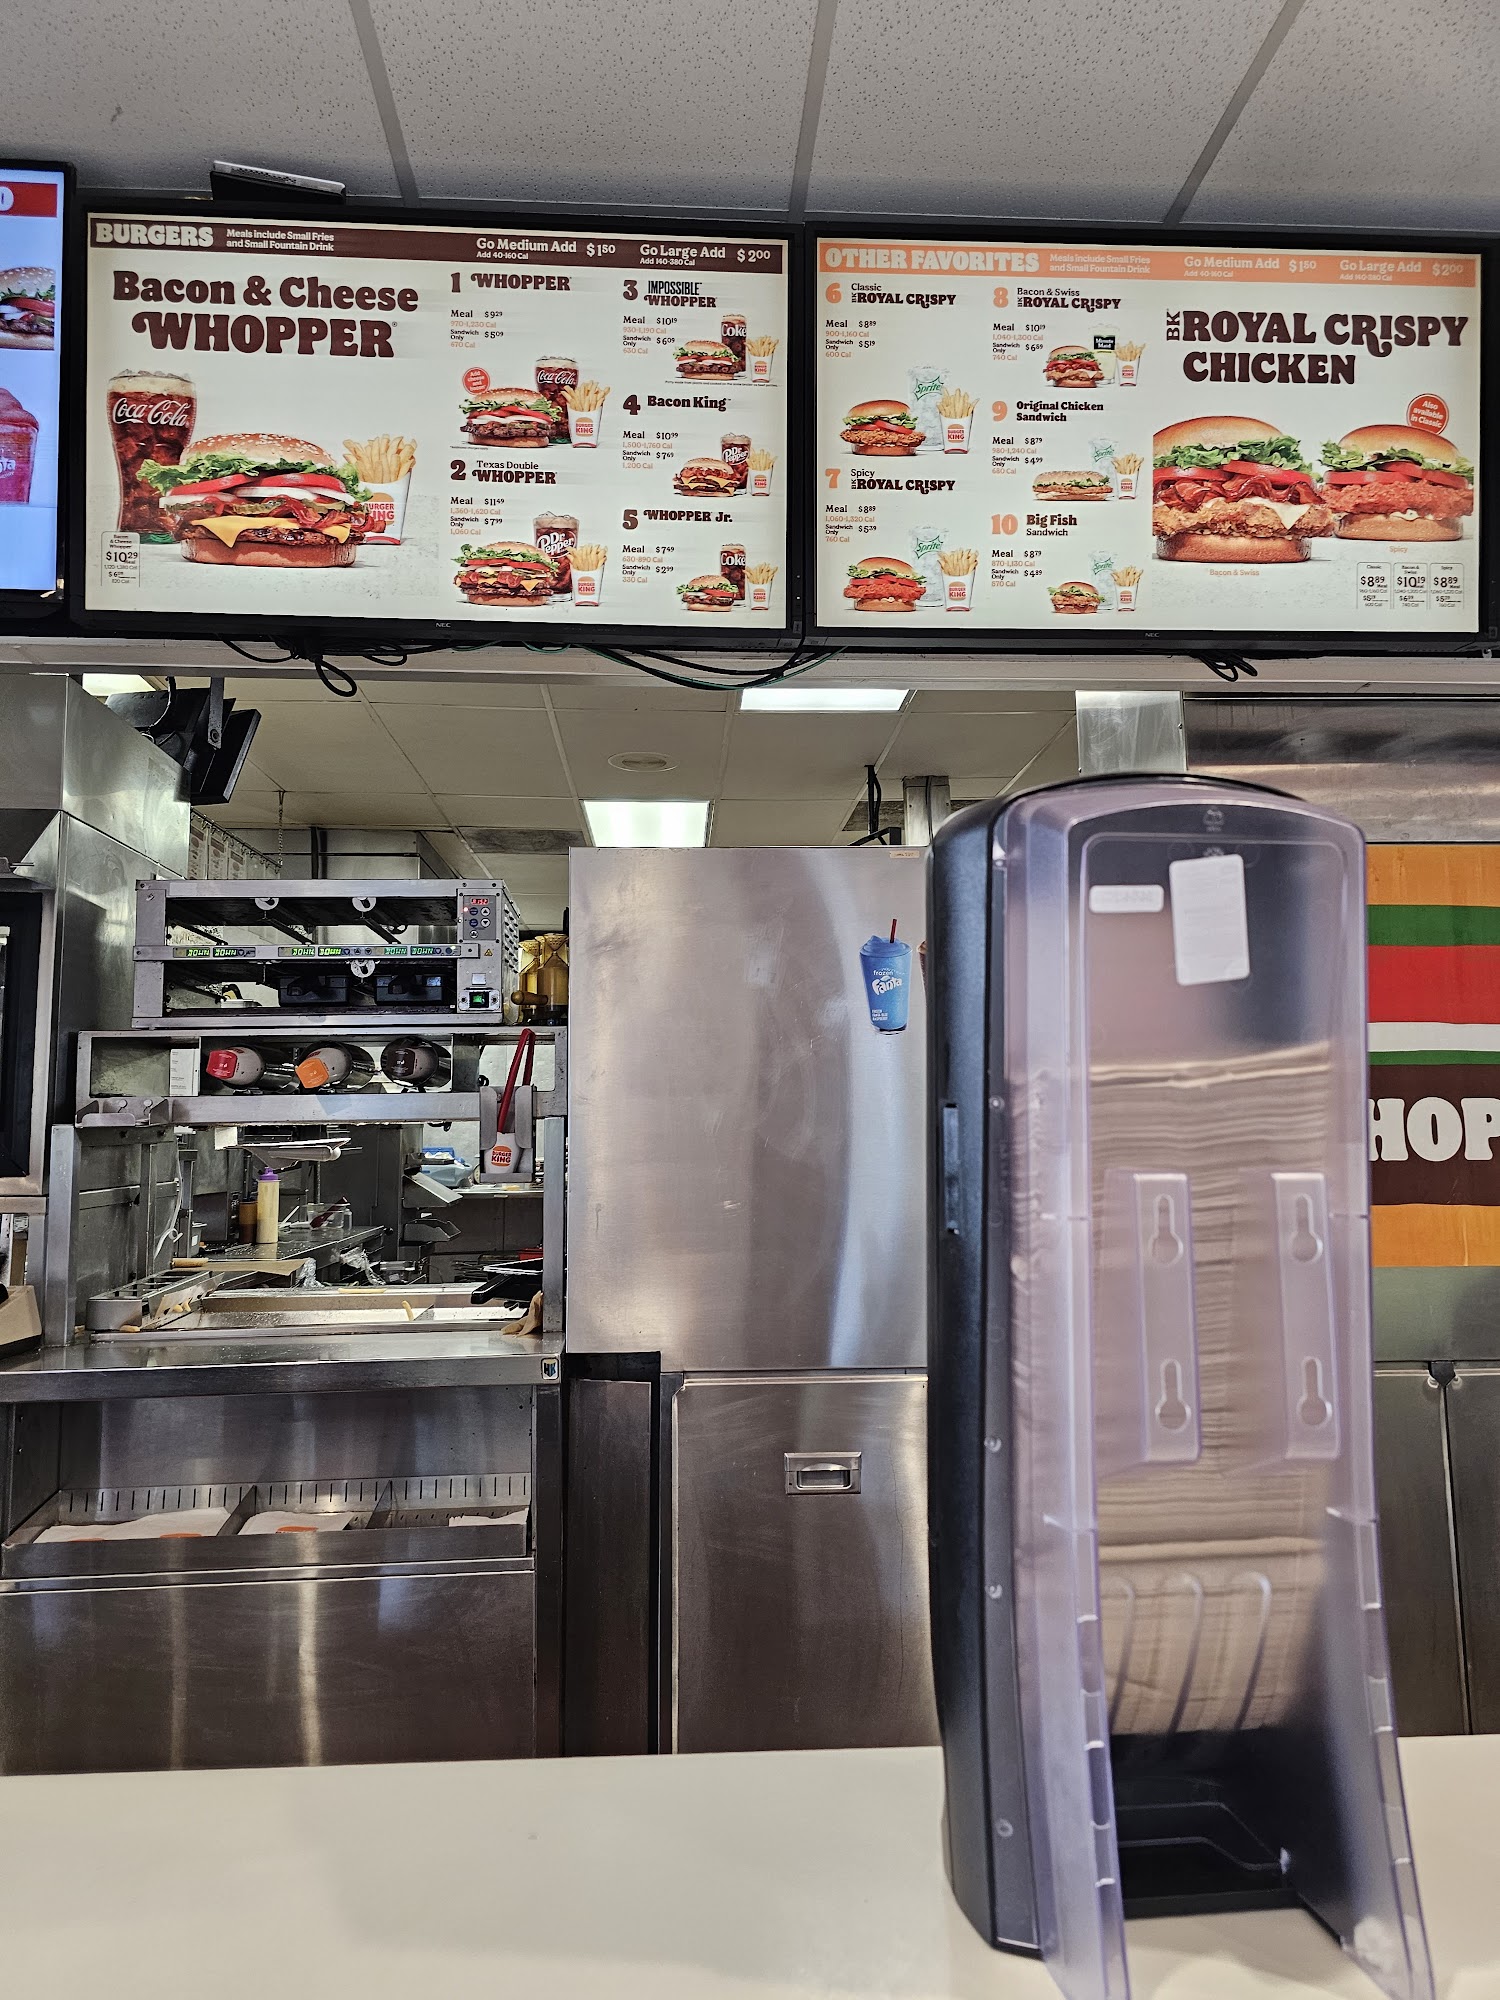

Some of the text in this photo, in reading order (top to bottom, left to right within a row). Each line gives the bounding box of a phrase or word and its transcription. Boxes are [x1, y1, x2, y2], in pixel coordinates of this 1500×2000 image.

[96, 223, 213, 247] BURGERS
[227, 229, 334, 241] Meals include Small Fries
[227, 240, 334, 251] and Small Fountain Drink
[476, 238, 494, 249] Go
[497, 239, 548, 251] Medium
[551, 241, 576, 252] Add
[640, 244, 657, 256] Go
[660, 246, 697, 259] Large
[700, 247, 725, 258] Add
[825, 248, 1040, 273] OTHER FAVORITES
[1050, 254, 1074, 262] Meals
[1106, 255, 1128, 263] Small
[1184, 257, 1200, 267] Go
[1204, 257, 1252, 268] Medium
[1255, 258, 1279, 269] Add
[1066, 264, 1088, 272] Small
[1090, 265, 1125, 273] Fountain
[1340, 260, 1357, 270] Go
[1359, 260, 1395, 274] Large
[1397, 262, 1421, 272] Add
[451, 272, 461, 292] 1
[113, 271, 418, 312] Bacon & Cheese
[623, 280, 700, 300] 3 IMPOSSIBLE
[825, 282, 881, 304] 6 Classic
[857, 293, 956, 308] ROYAL CRISPY
[993, 287, 1008, 308] 8
[1017, 288, 1044, 296] Bacon
[1046, 288, 1053, 296] &
[1023, 297, 1121, 313] ROYAL CRISPY
[451, 310, 472, 318] Meal
[623, 316, 645, 324] Meal
[721, 324, 746, 337] Coke
[825, 320, 848, 328] Meal
[993, 323, 1015, 331] Meal
[1166, 311, 1468, 357] BK ROYAL CRISPY
[1183, 351, 1356, 385] CHICKEN
[537, 370, 576, 385] Coca-Cola
[917, 382, 941, 394] Sprite
[113, 398, 191, 426] Coca-Cola
[623, 395, 726, 415] 4 Bacon King
[992, 401, 1104, 422] 9 Original Chicken
[1422, 401, 1438, 410] Also
[1017, 412, 1067, 422] Sandwich
[1413, 408, 1443, 419] available
[1411, 414, 1442, 428] in Classic
[451, 460, 539, 480] 2 Texas Double
[825, 469, 875, 489] 7 Spicy
[857, 479, 956, 494] ROYAL CRISPY
[825, 505, 848, 513] Meal
[622, 509, 638, 530] 5
[715, 512, 733, 523] Jr.
[991, 514, 1077, 536] 10 Big Fish
[550, 531, 565, 543] Dr
[1026, 528, 1068, 536] Sandwich
[537, 534, 574, 555] Pepper
[622, 545, 645, 553] Meal
[918, 543, 941, 553] Sprite
[721, 553, 746, 566] Coke
[872, 977, 902, 996] Fanta
